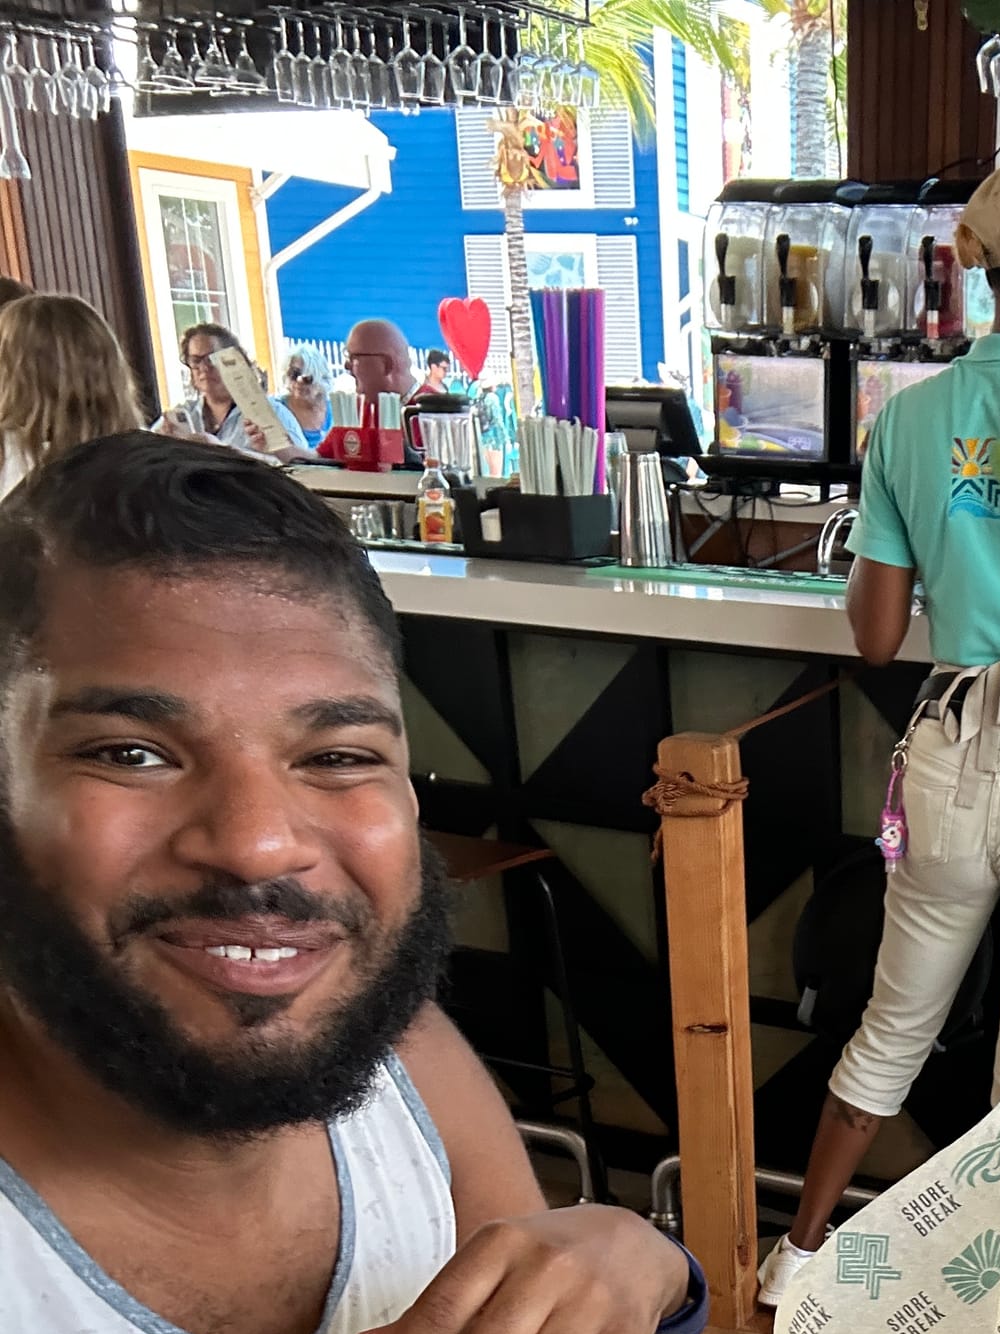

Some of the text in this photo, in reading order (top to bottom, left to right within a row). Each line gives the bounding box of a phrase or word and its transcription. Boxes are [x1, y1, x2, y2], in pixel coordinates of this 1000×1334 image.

[901, 1179, 949, 1222] SHORE
[912, 1194, 962, 1238] BREAK
[886, 1290, 932, 1332] SHORE
